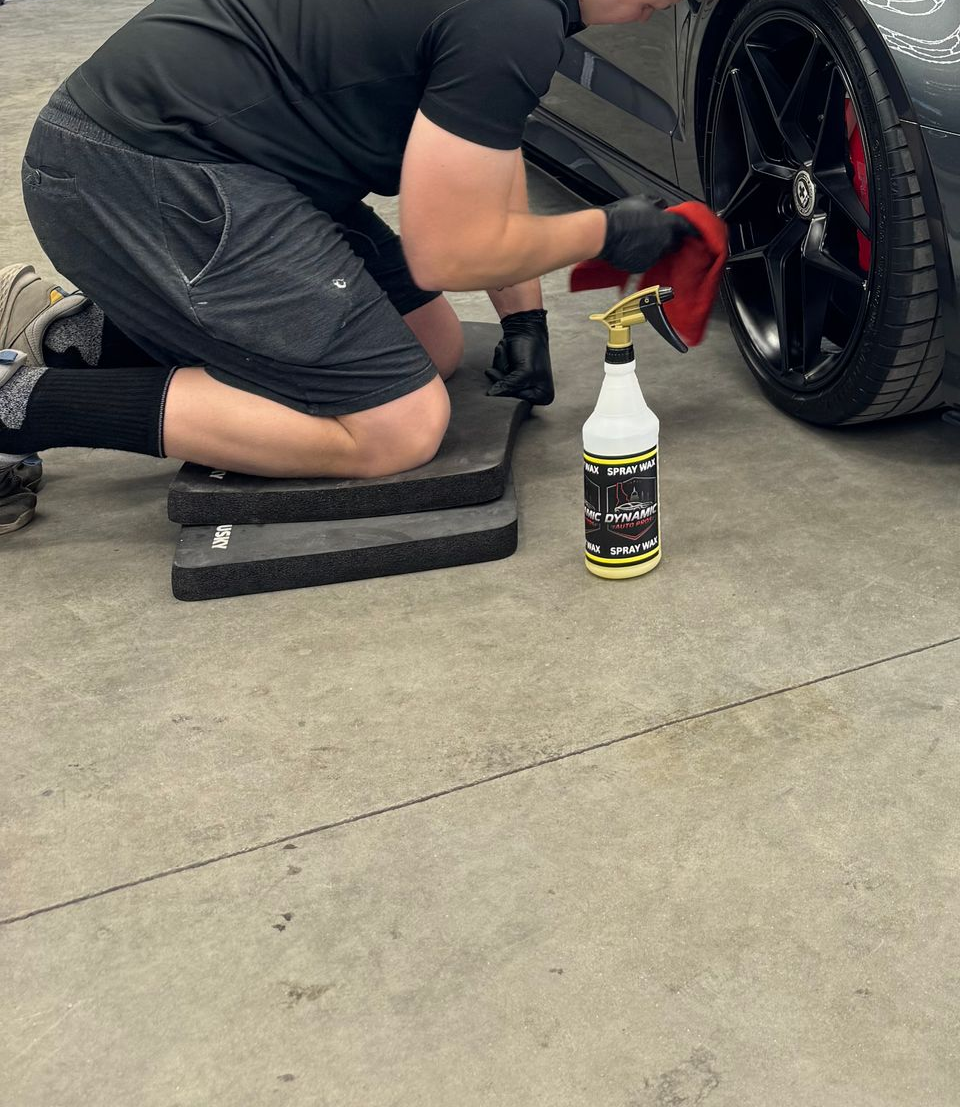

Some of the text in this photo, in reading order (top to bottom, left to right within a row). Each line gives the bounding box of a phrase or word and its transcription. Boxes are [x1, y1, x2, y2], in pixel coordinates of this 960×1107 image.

[607, 464, 638, 476] SPRAY
[639, 457, 656, 472] WAX
[605, 503, 658, 523] DYNAMIC
[211, 524, 233, 550] USKY
[610, 543, 641, 555] SPRAY
[642, 536, 658, 550] WAX
